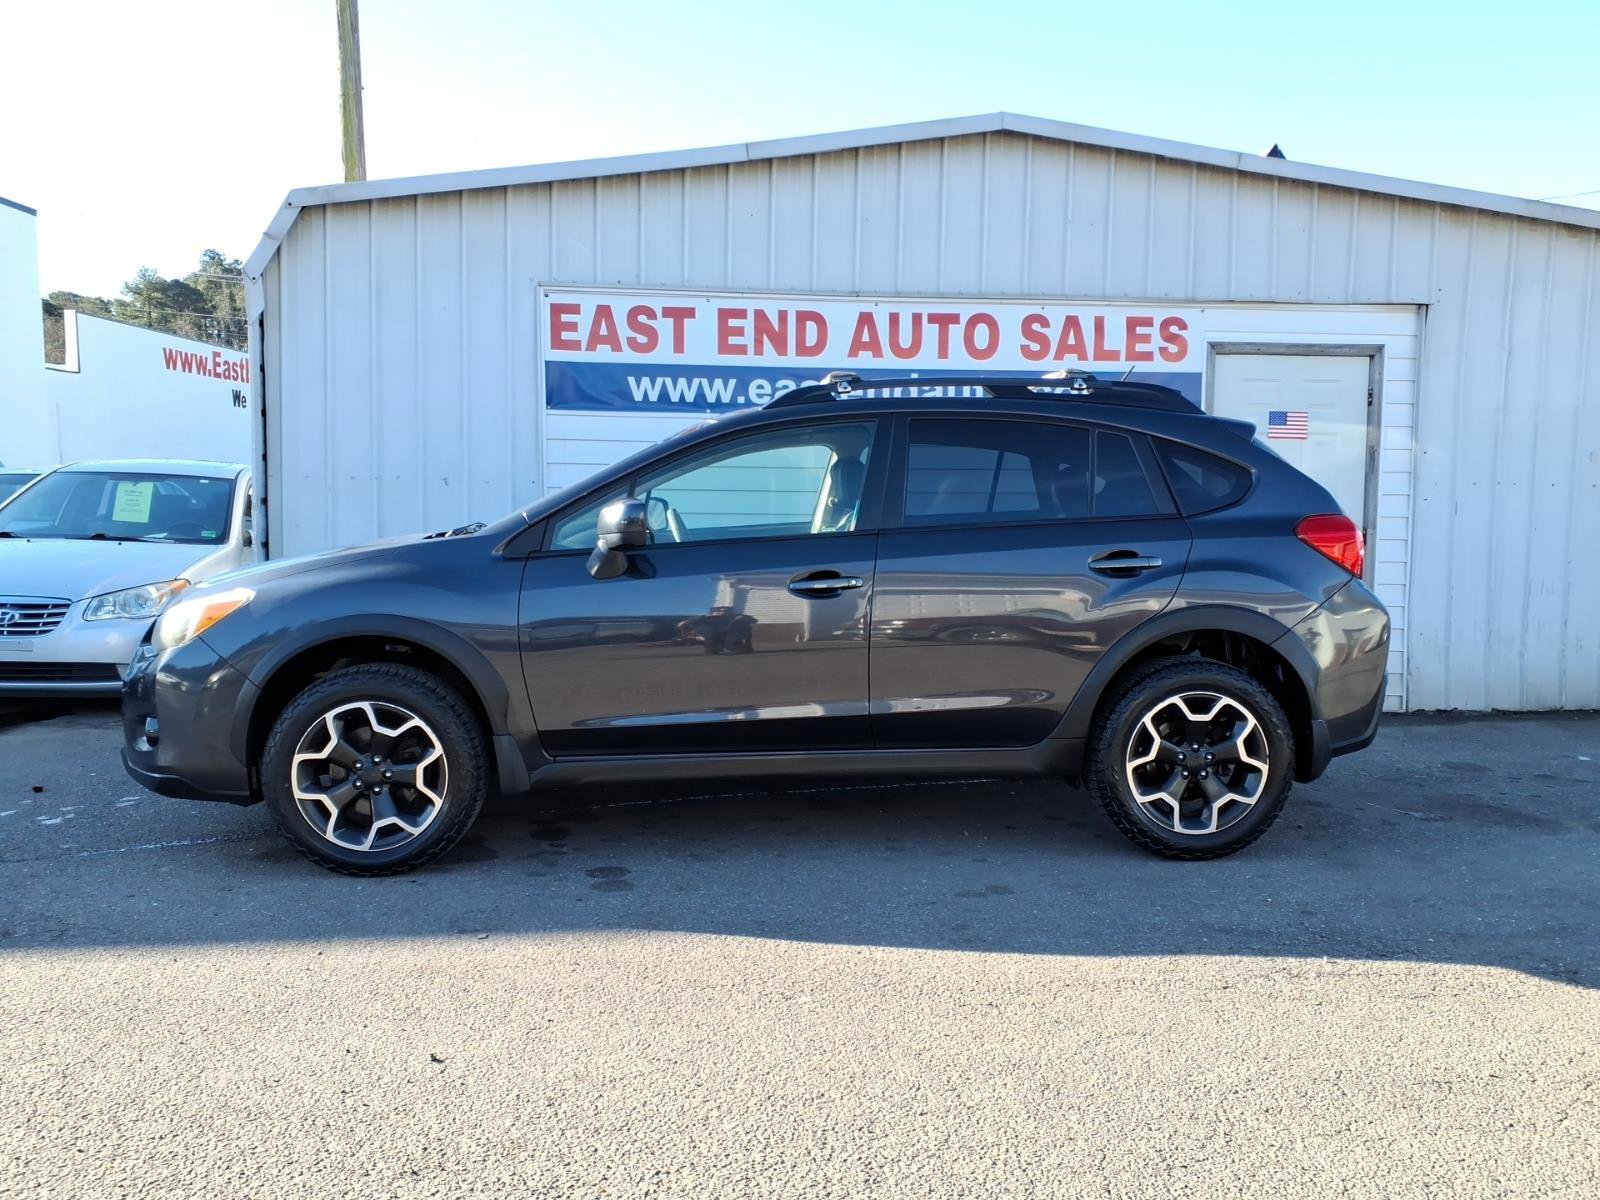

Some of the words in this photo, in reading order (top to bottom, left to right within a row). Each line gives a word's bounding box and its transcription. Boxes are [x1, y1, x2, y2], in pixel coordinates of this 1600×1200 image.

[549, 302, 696, 354] EAST
[717, 307, 829, 358] END
[847, 310, 1000, 361] AUTO
[1019, 313, 1189, 363] SALES
[231, 388, 248, 409] We
